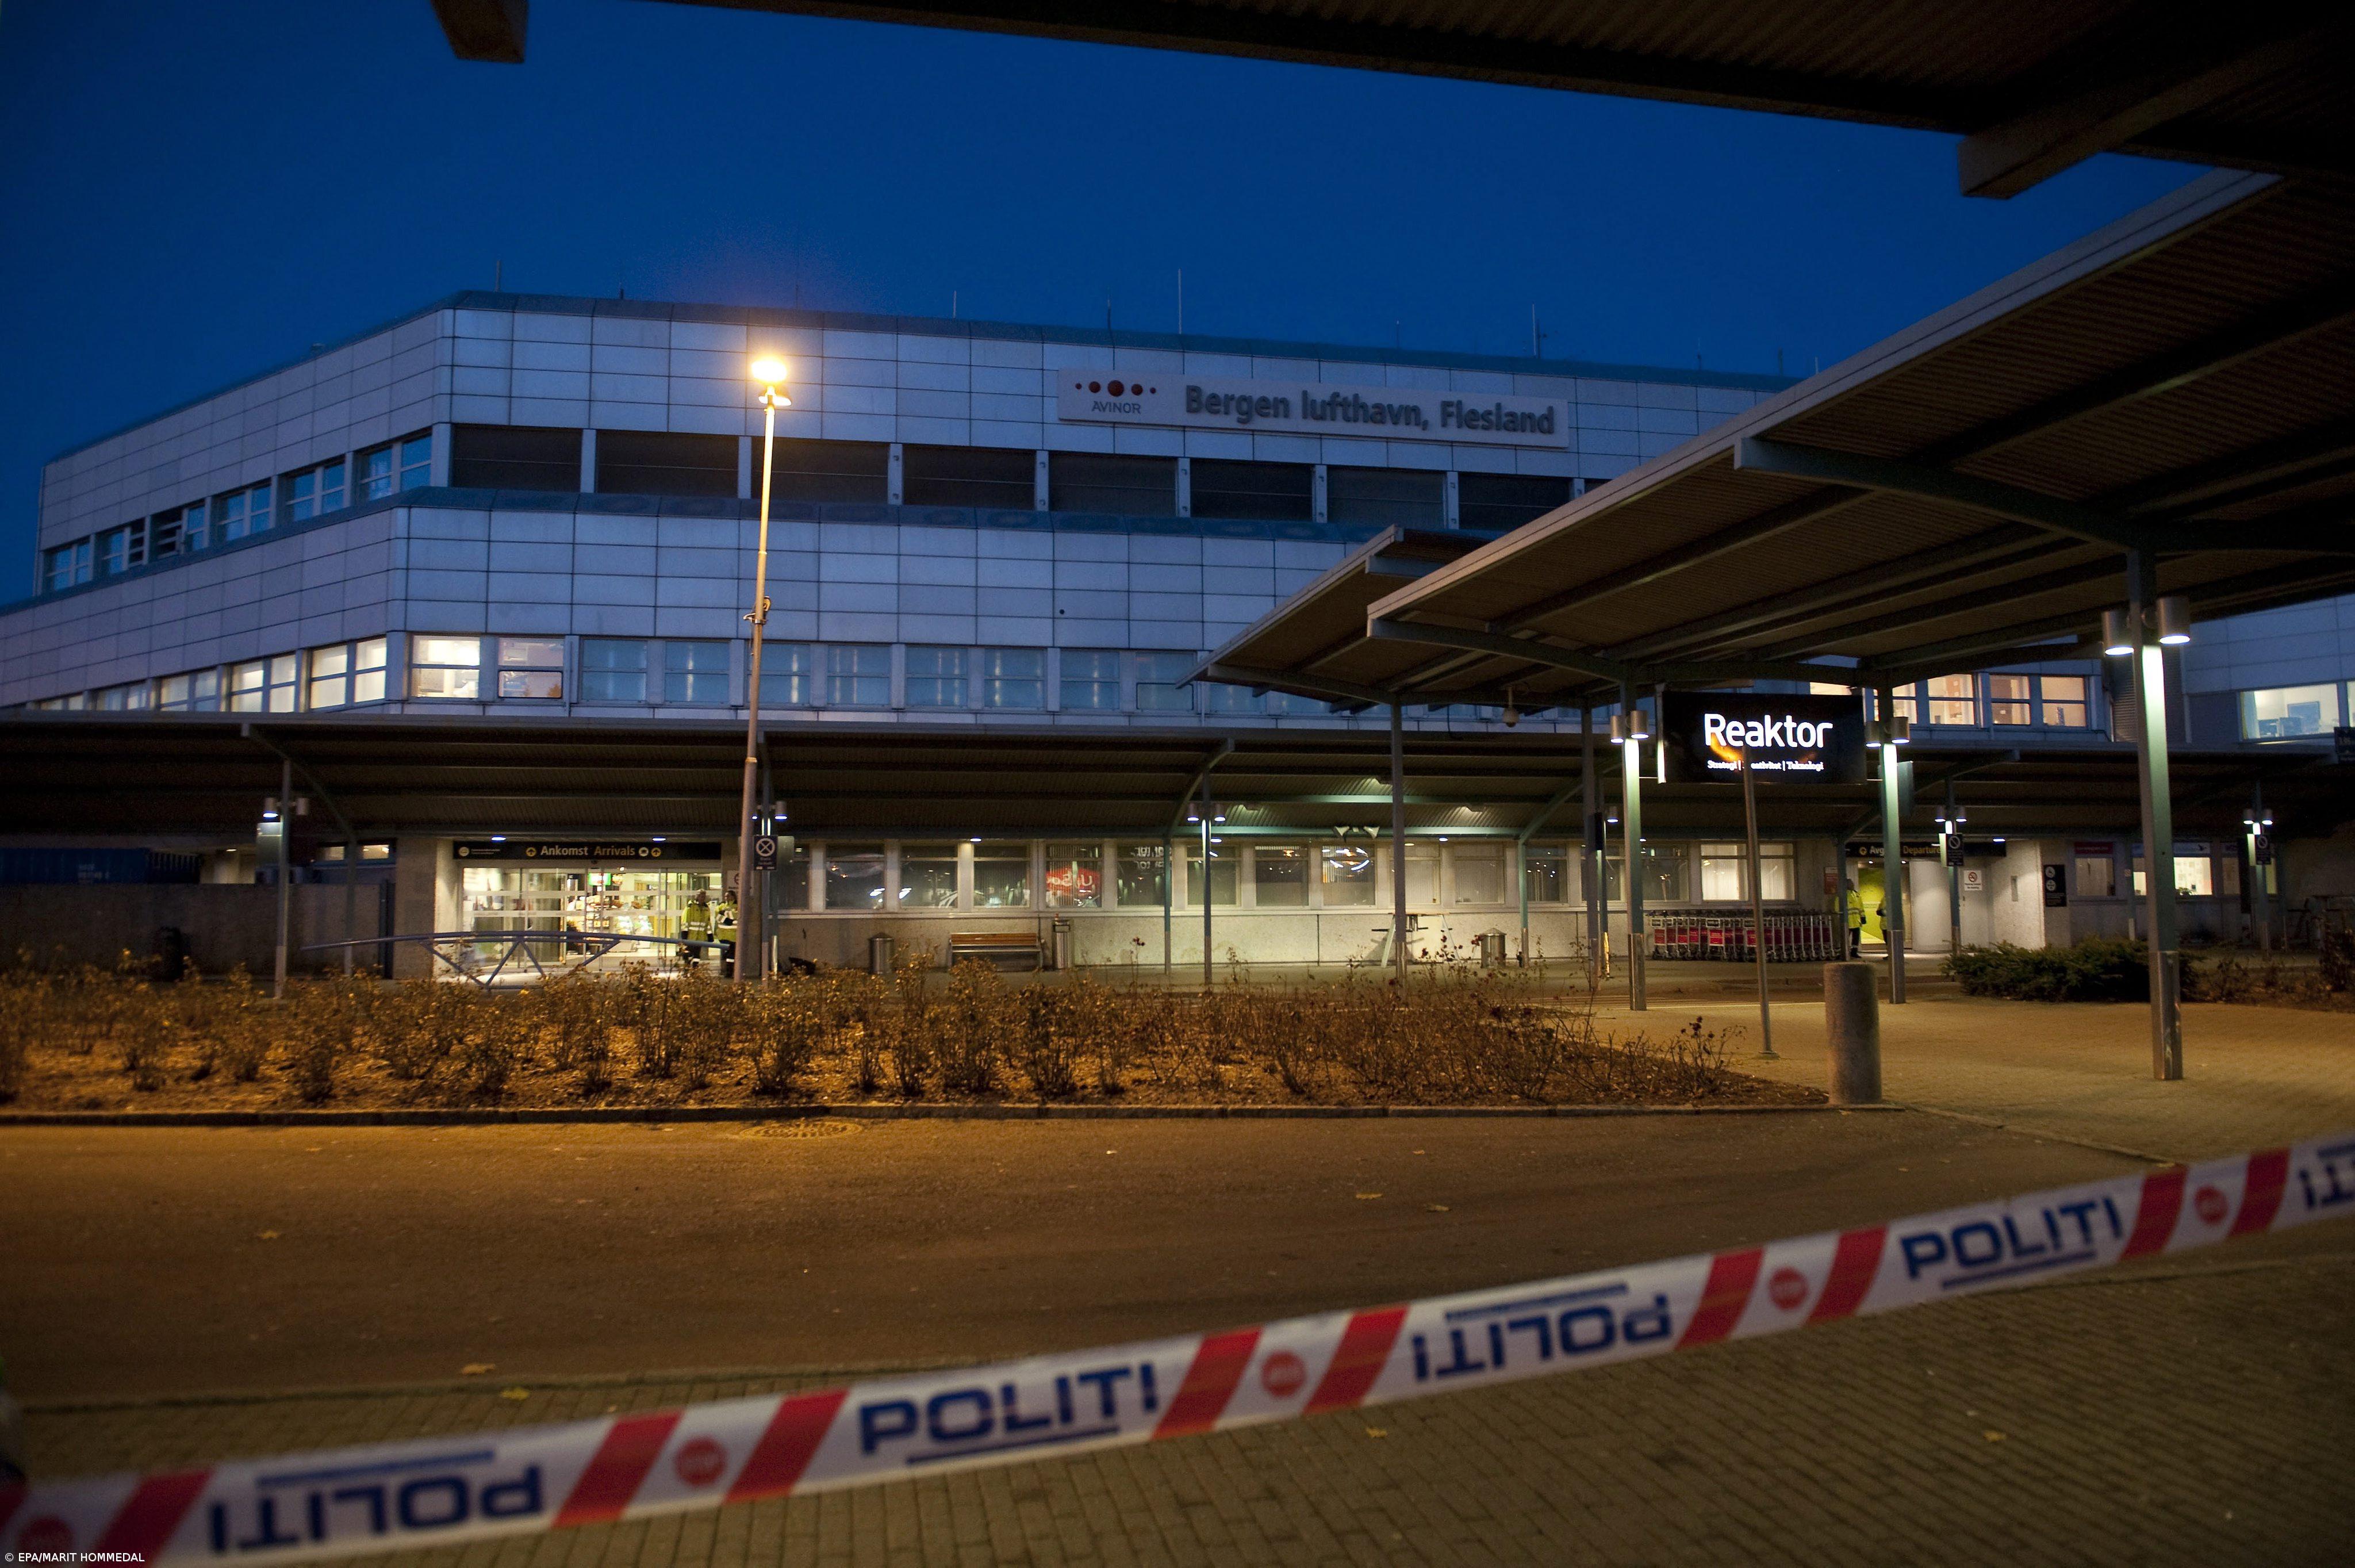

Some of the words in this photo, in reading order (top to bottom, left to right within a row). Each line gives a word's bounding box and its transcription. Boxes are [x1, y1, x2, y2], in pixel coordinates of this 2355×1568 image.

[1091, 400, 1141, 414] AVINOR
[1186, 385, 1290, 424] Bergen
[1301, 390, 1429, 430] lufthavn,
[1440, 400, 1555, 434] Flesland
[1704, 713, 1834, 748] Reaktor
[540, 845, 589, 857] Ankomst
[594, 845, 635, 857] Arrivals
[1869, 845, 1885, 857] Avg
[1903, 845, 1942, 856] Departure
[1900, 1197, 2123, 1280] POLITI
[1410, 1293, 1673, 1382] POLITI
[858, 1360, 1160, 1457] POLITI
[206, 1464, 544, 1556] POLITI
